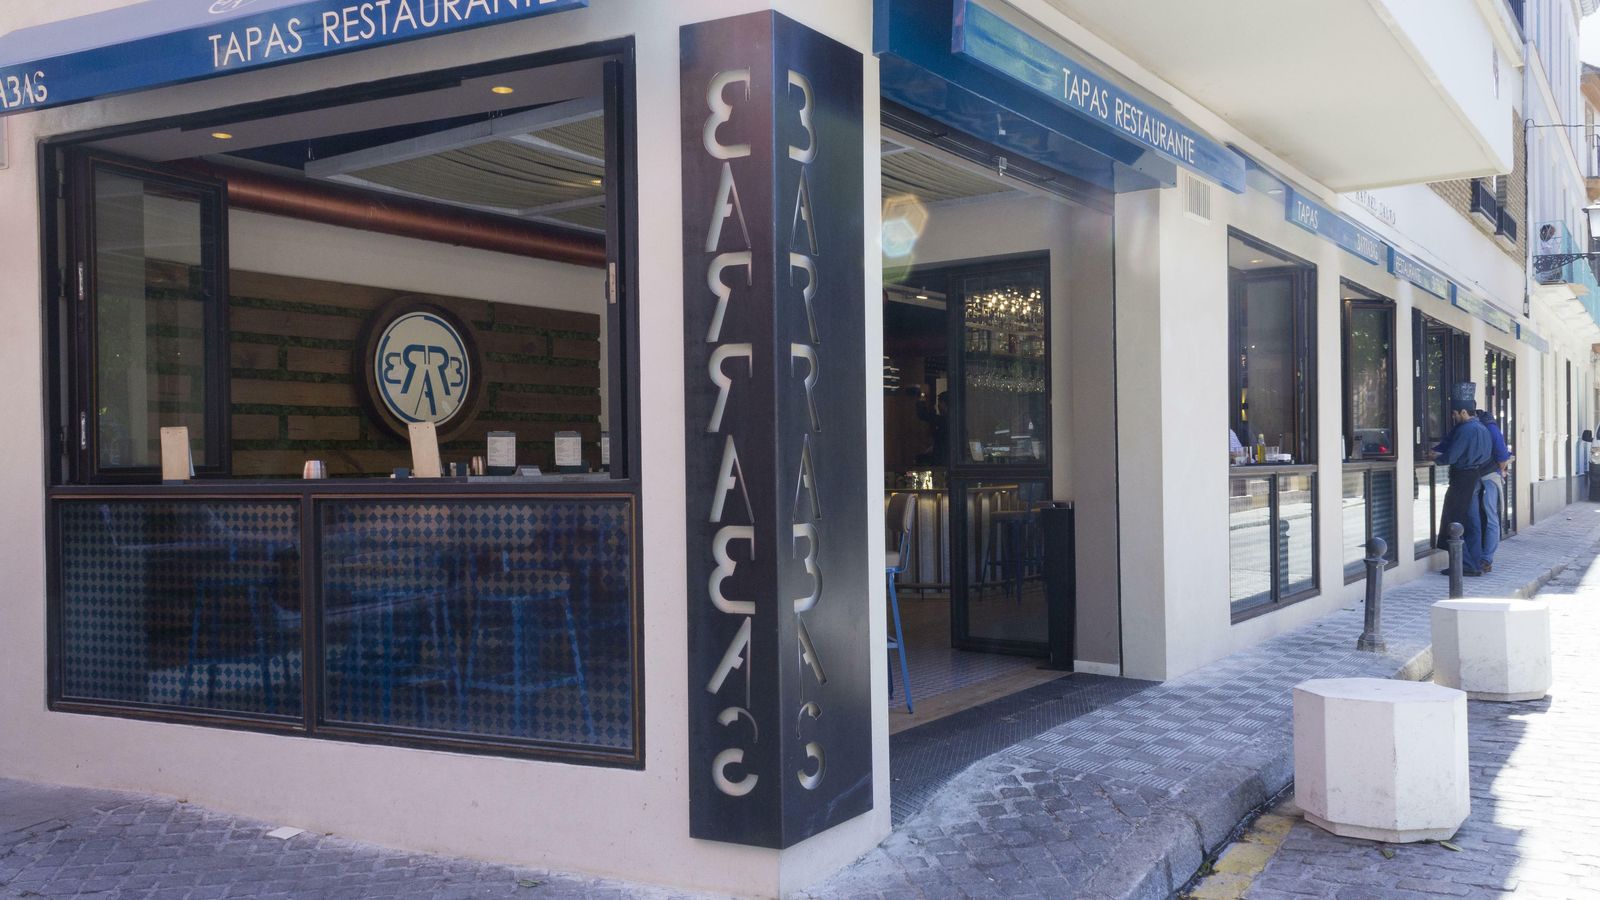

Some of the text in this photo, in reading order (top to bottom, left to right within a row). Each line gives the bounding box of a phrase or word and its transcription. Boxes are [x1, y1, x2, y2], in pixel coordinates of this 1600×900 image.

[208, 0, 556, 67] TAPAS RESTAURA
[1062, 67, 1195, 164] TAPAS RESTAURANTE
[1296, 200, 1319, 230] TAPAS
[787, 69, 828, 792] BARRABAS
